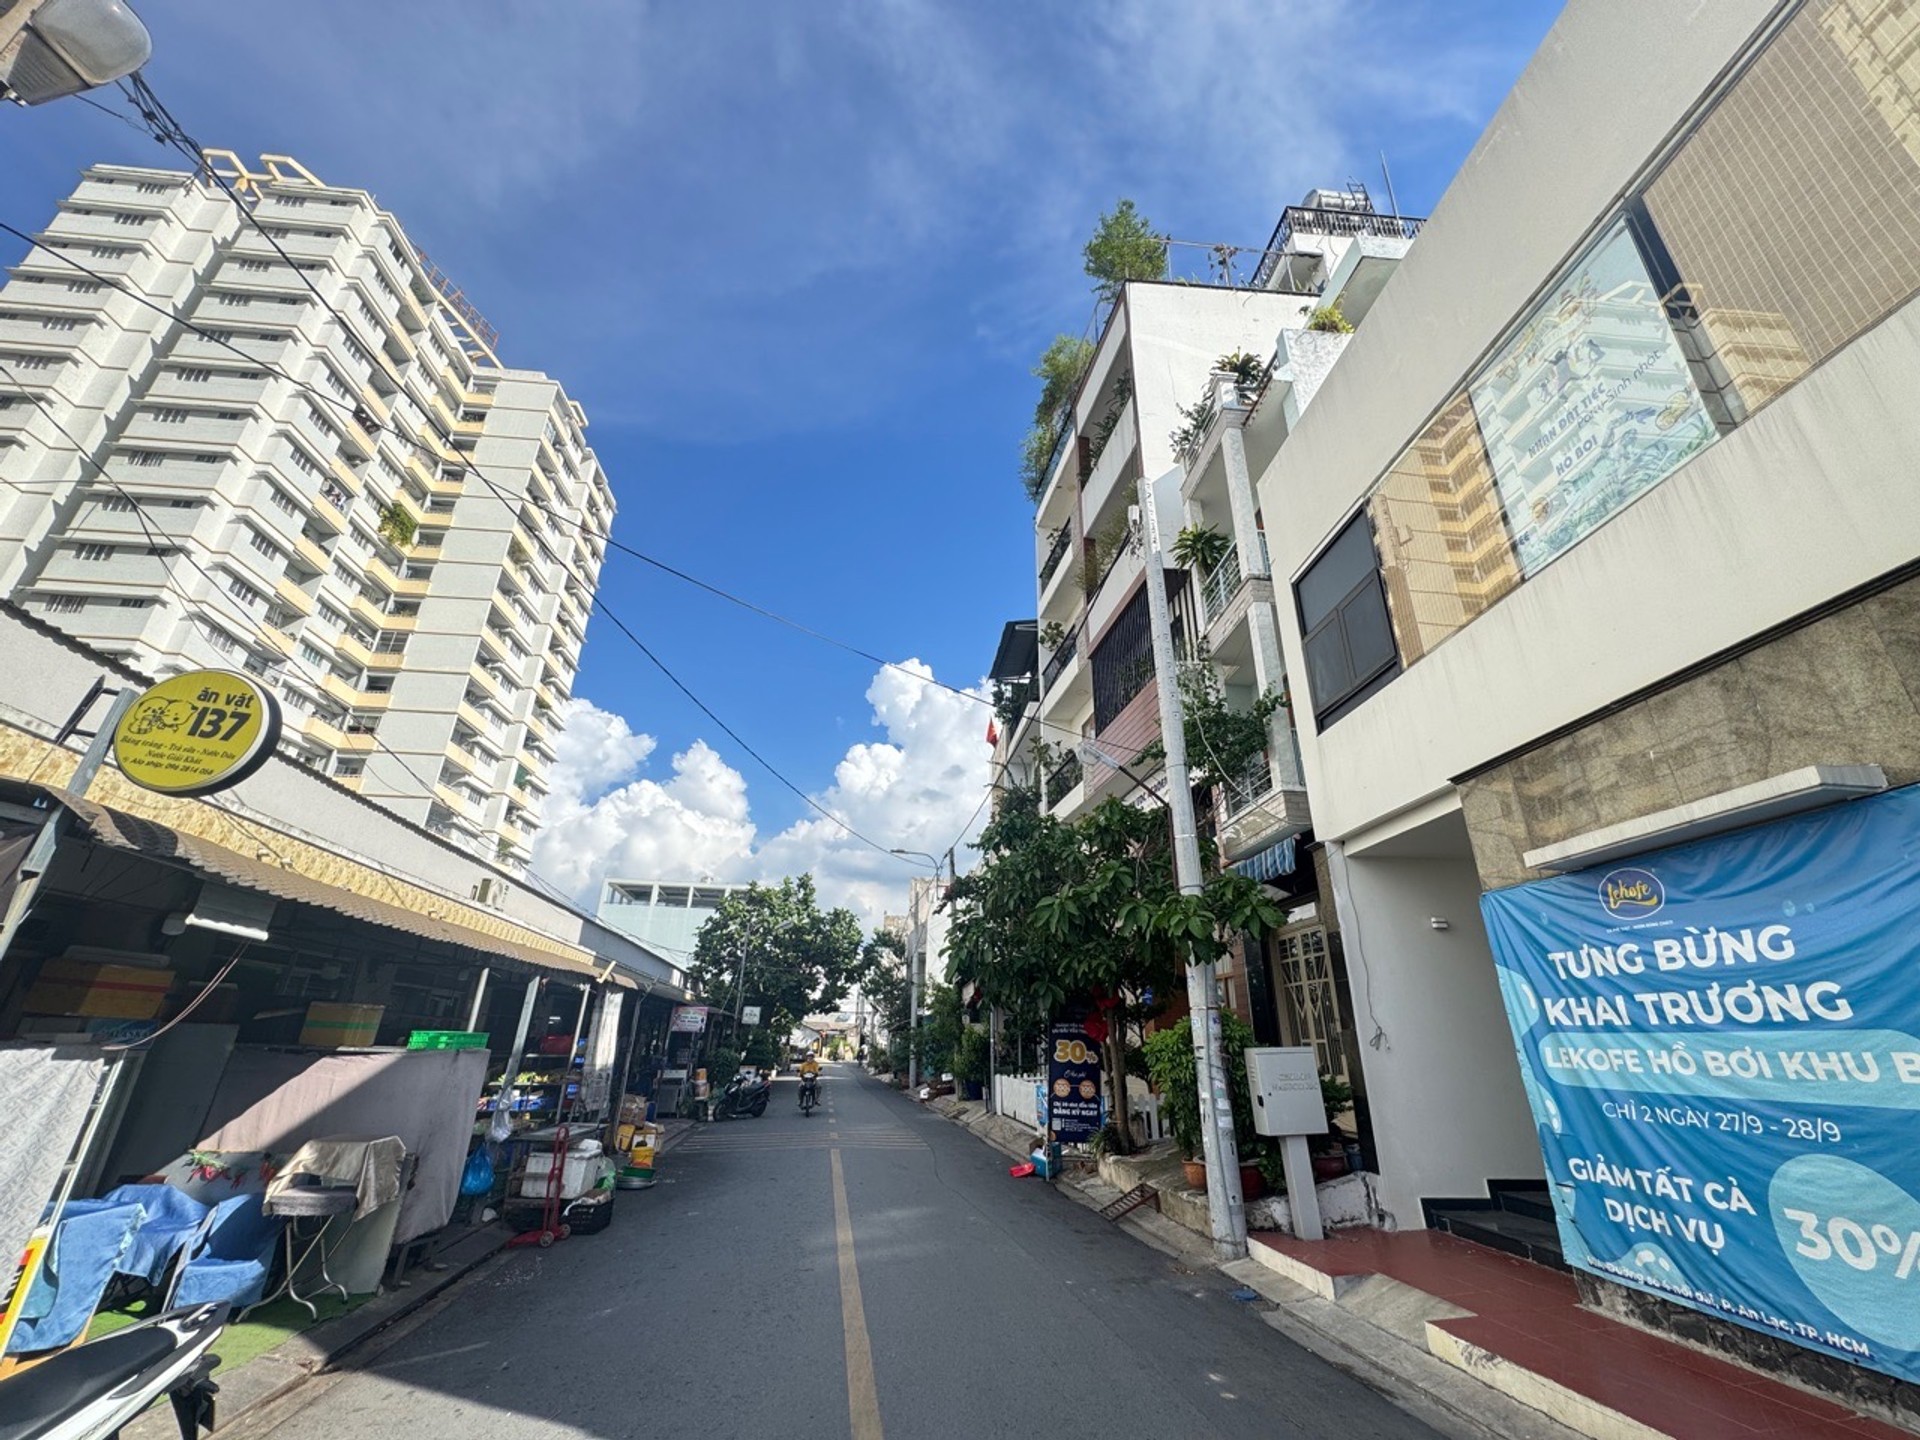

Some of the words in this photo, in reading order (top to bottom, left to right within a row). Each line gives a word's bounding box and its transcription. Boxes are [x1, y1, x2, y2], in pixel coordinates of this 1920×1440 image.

[196, 687, 219, 704] ăn
[225, 691, 255, 711] vặt
[187, 706, 252, 742] 137
[1548, 941, 1645, 982] TƯNG
[1654, 923, 1797, 972] BỪNG
[1543, 994, 1630, 1028] KHAI
[1634, 977, 1855, 1027] TRƯƠNG
[1053, 1039, 1099, 1064] 30%
[1543, 1045, 1644, 1075] LEKOFE
[1648, 1040, 1697, 1078] HỒ
[1704, 1045, 1772, 1080] BƠI
[1779, 1050, 1881, 1083] KHU
[1602, 1098, 1637, 1121] CHỈ
[1642, 1105, 1654, 1123] 2
[1657, 1104, 1711, 1129] NGÀY
[1716, 1111, 1764, 1135] 27/9
[1782, 1116, 1842, 1143] 28/9
[1568, 1154, 1637, 1192] GIẢM
[1636, 1165, 1694, 1204] TẤT
[1704, 1175, 1758, 1217] CẢ
[1604, 1198, 1671, 1239] DỊCH
[1673, 1218, 1726, 1257] VỤ
[1738, 1304, 1760, 1321] An
[1795, 1321, 1824, 1342] TP.
[1825, 1331, 1870, 1357] HCM
